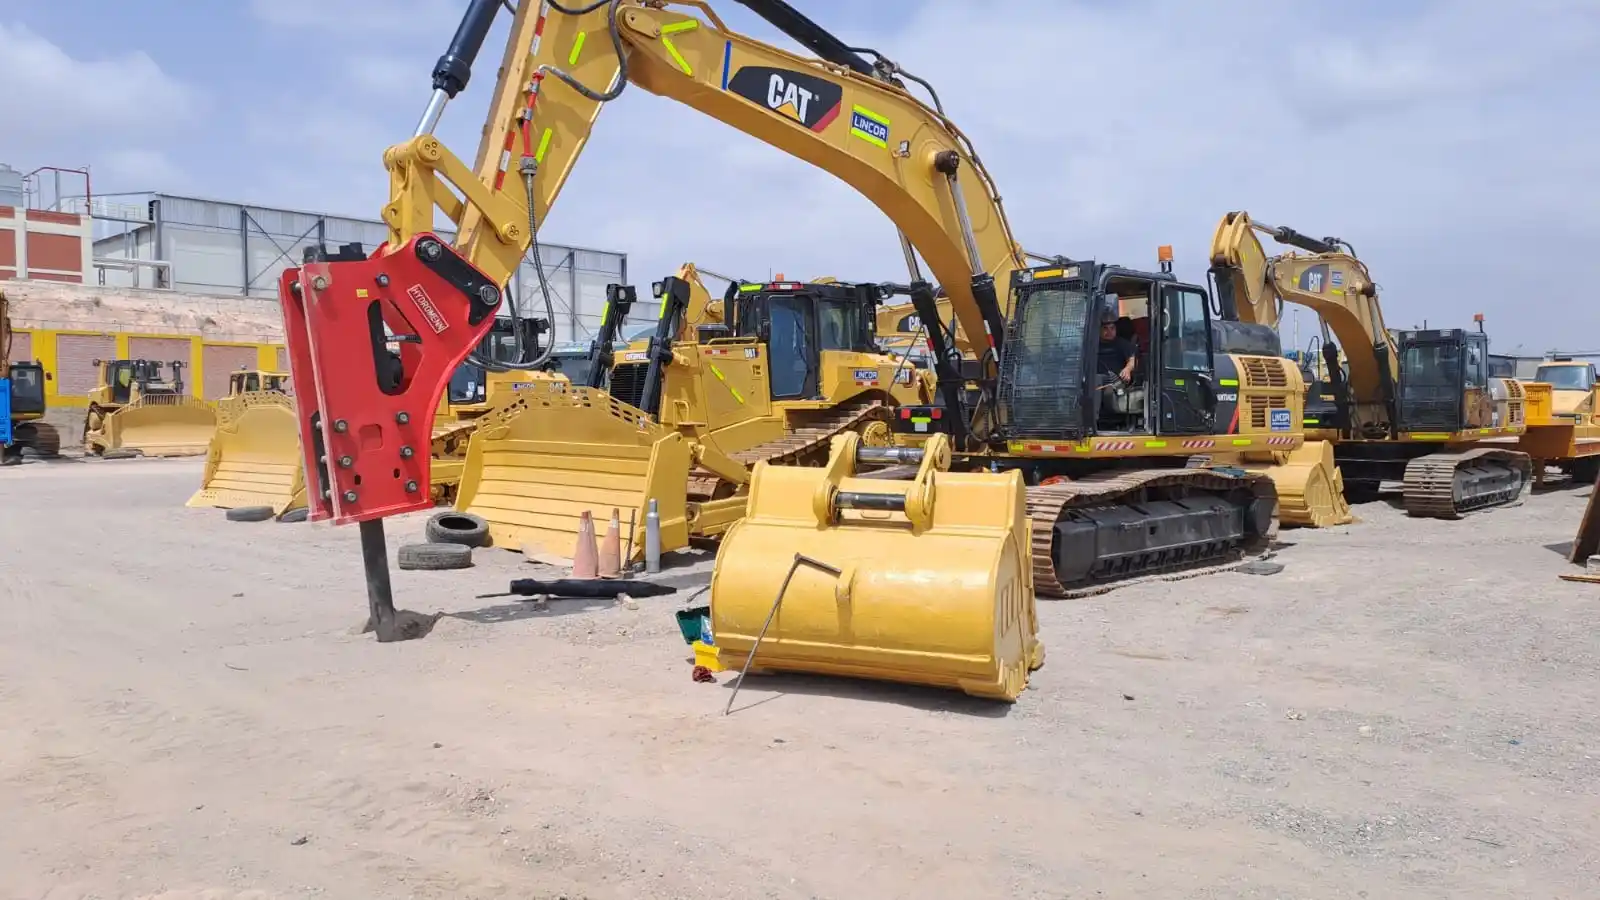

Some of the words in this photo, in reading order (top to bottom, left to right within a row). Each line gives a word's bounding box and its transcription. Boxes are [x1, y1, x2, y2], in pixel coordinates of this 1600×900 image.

[767, 73, 813, 123] CAT
[854, 115, 887, 139] LINCOR
[908, 315, 921, 331] CA
[855, 370, 877, 379] LINCOR
